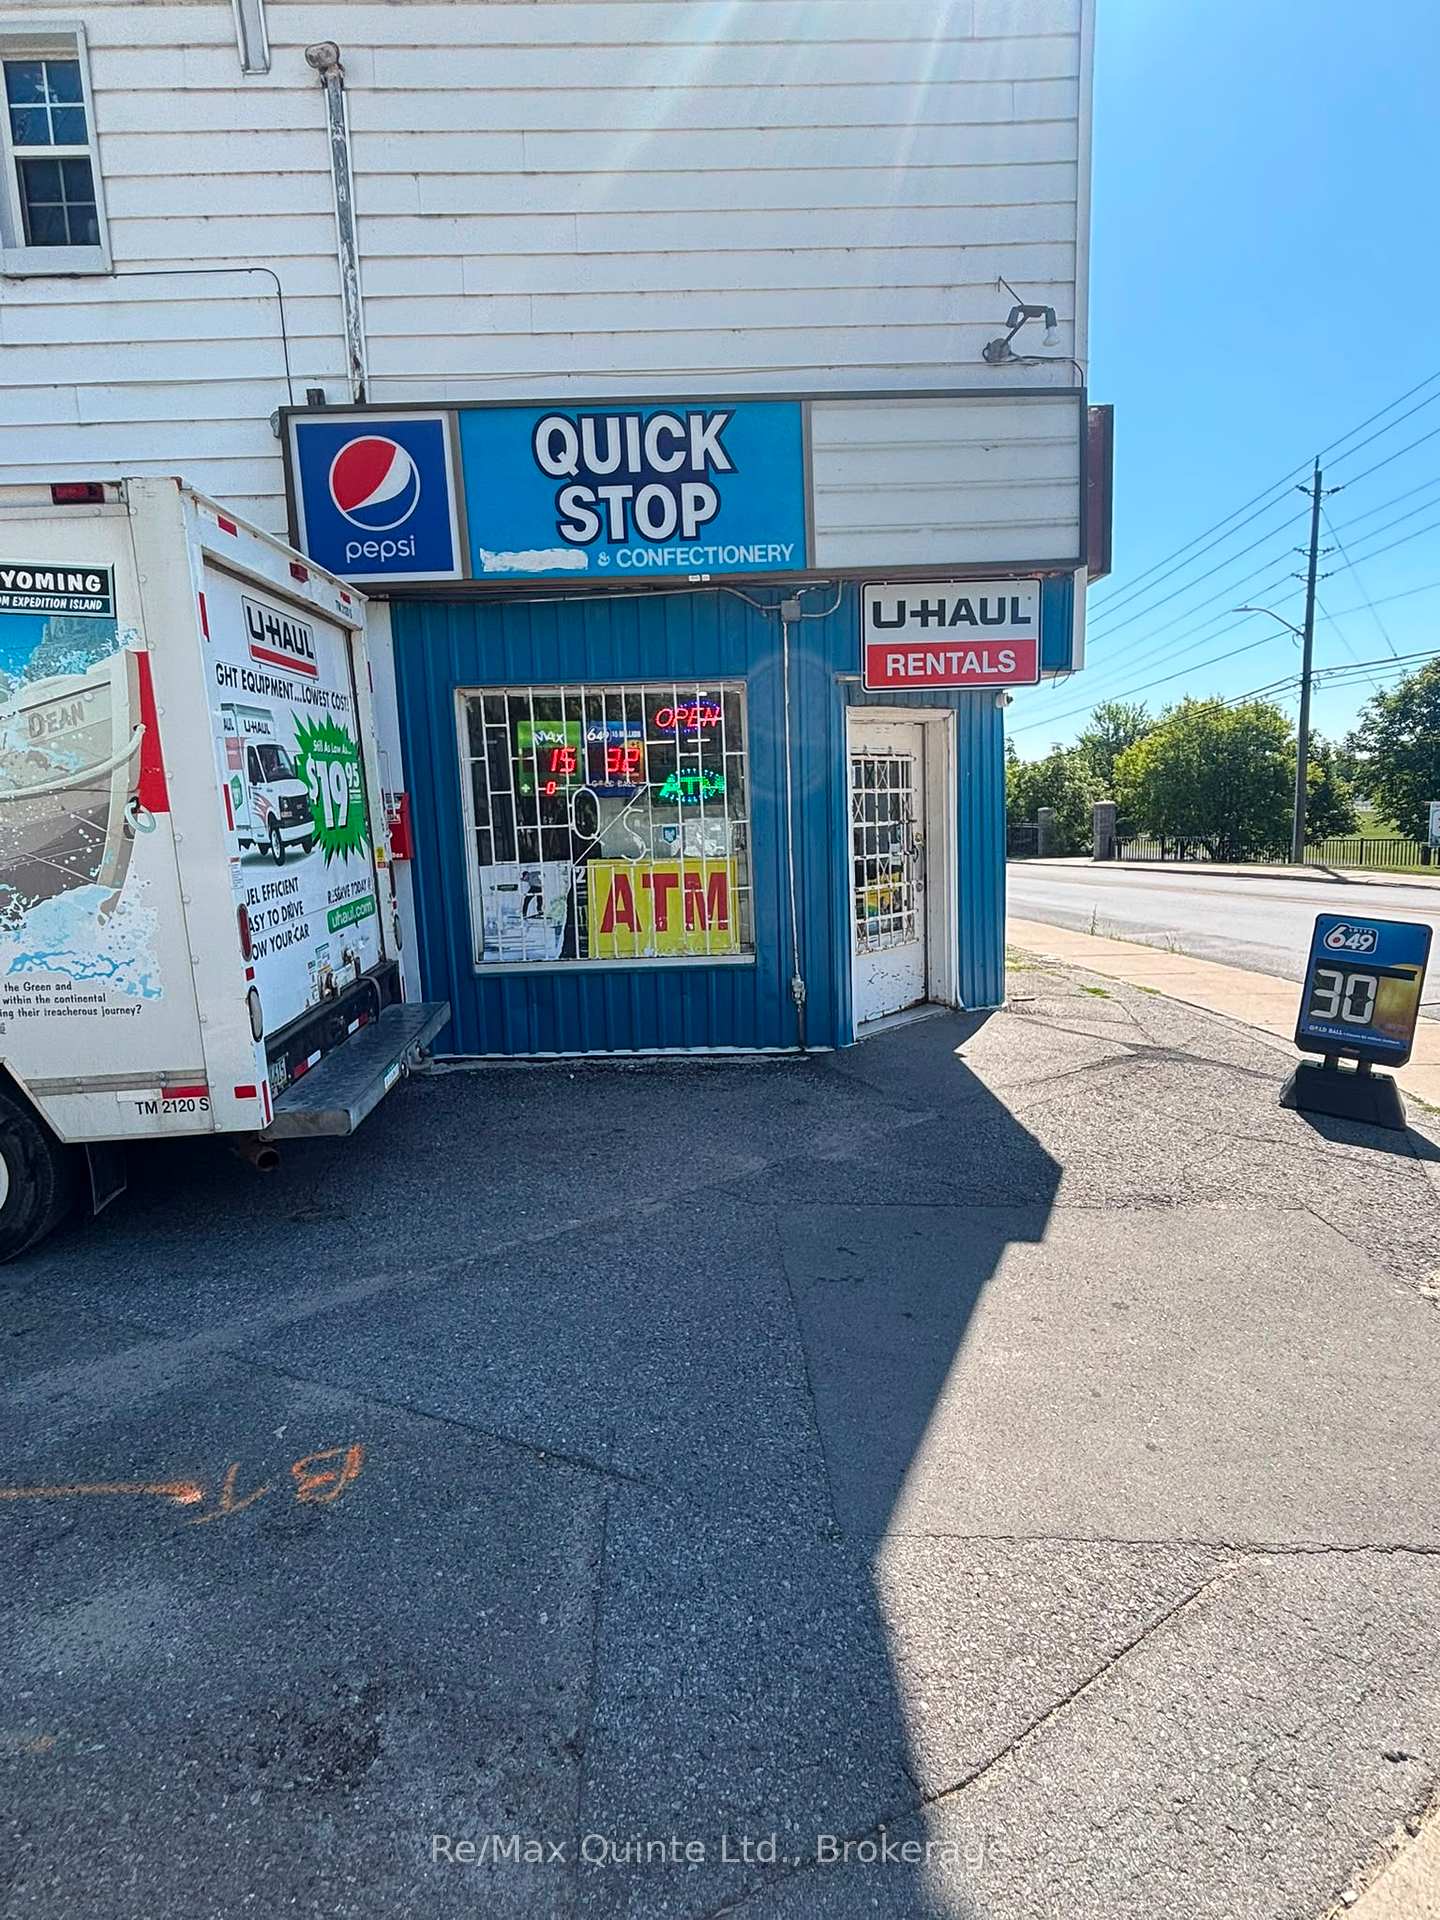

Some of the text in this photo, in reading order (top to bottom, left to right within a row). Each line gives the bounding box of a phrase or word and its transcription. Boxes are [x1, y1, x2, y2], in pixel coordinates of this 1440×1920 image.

[534, 412, 735, 478] QUICK
[557, 481, 719, 543] STOP
[346, 534, 417, 564] pepsi
[598, 543, 795, 568] & CONFECTIONERY
[13, 596, 67, 609] EXPEDITION
[70, 598, 103, 611] ISLAND
[872, 596, 1032, 629] U-HAUL
[246, 605, 315, 660] U-HAUL
[886, 649, 1016, 677] RENTALS
[28, 701, 85, 738] DEAN
[655, 706, 721, 728] OPEN
[550, 747, 577, 773] 15
[659, 775, 726, 797] ATM
[261, 876, 300, 902] EFFICIENT
[600, 871, 729, 934] ATM
[267, 908, 280, 927] TO
[281, 900, 305, 922] DRIVE
[331, 901, 373, 929] uhaul.com
[269, 930, 294, 953] YOUR
[293, 922, 311, 942] CAR
[3, 993, 107, 1005] within the continental
[4, 981, 73, 993] the Green and
[1309, 968, 1378, 1025] 30
[18, 1006, 41, 1018] their
[44, 1005, 99, 1017] treacherous
[101, 1004, 143, 1018] journey?
[135, 1098, 210, 1115] TM 2120 S
